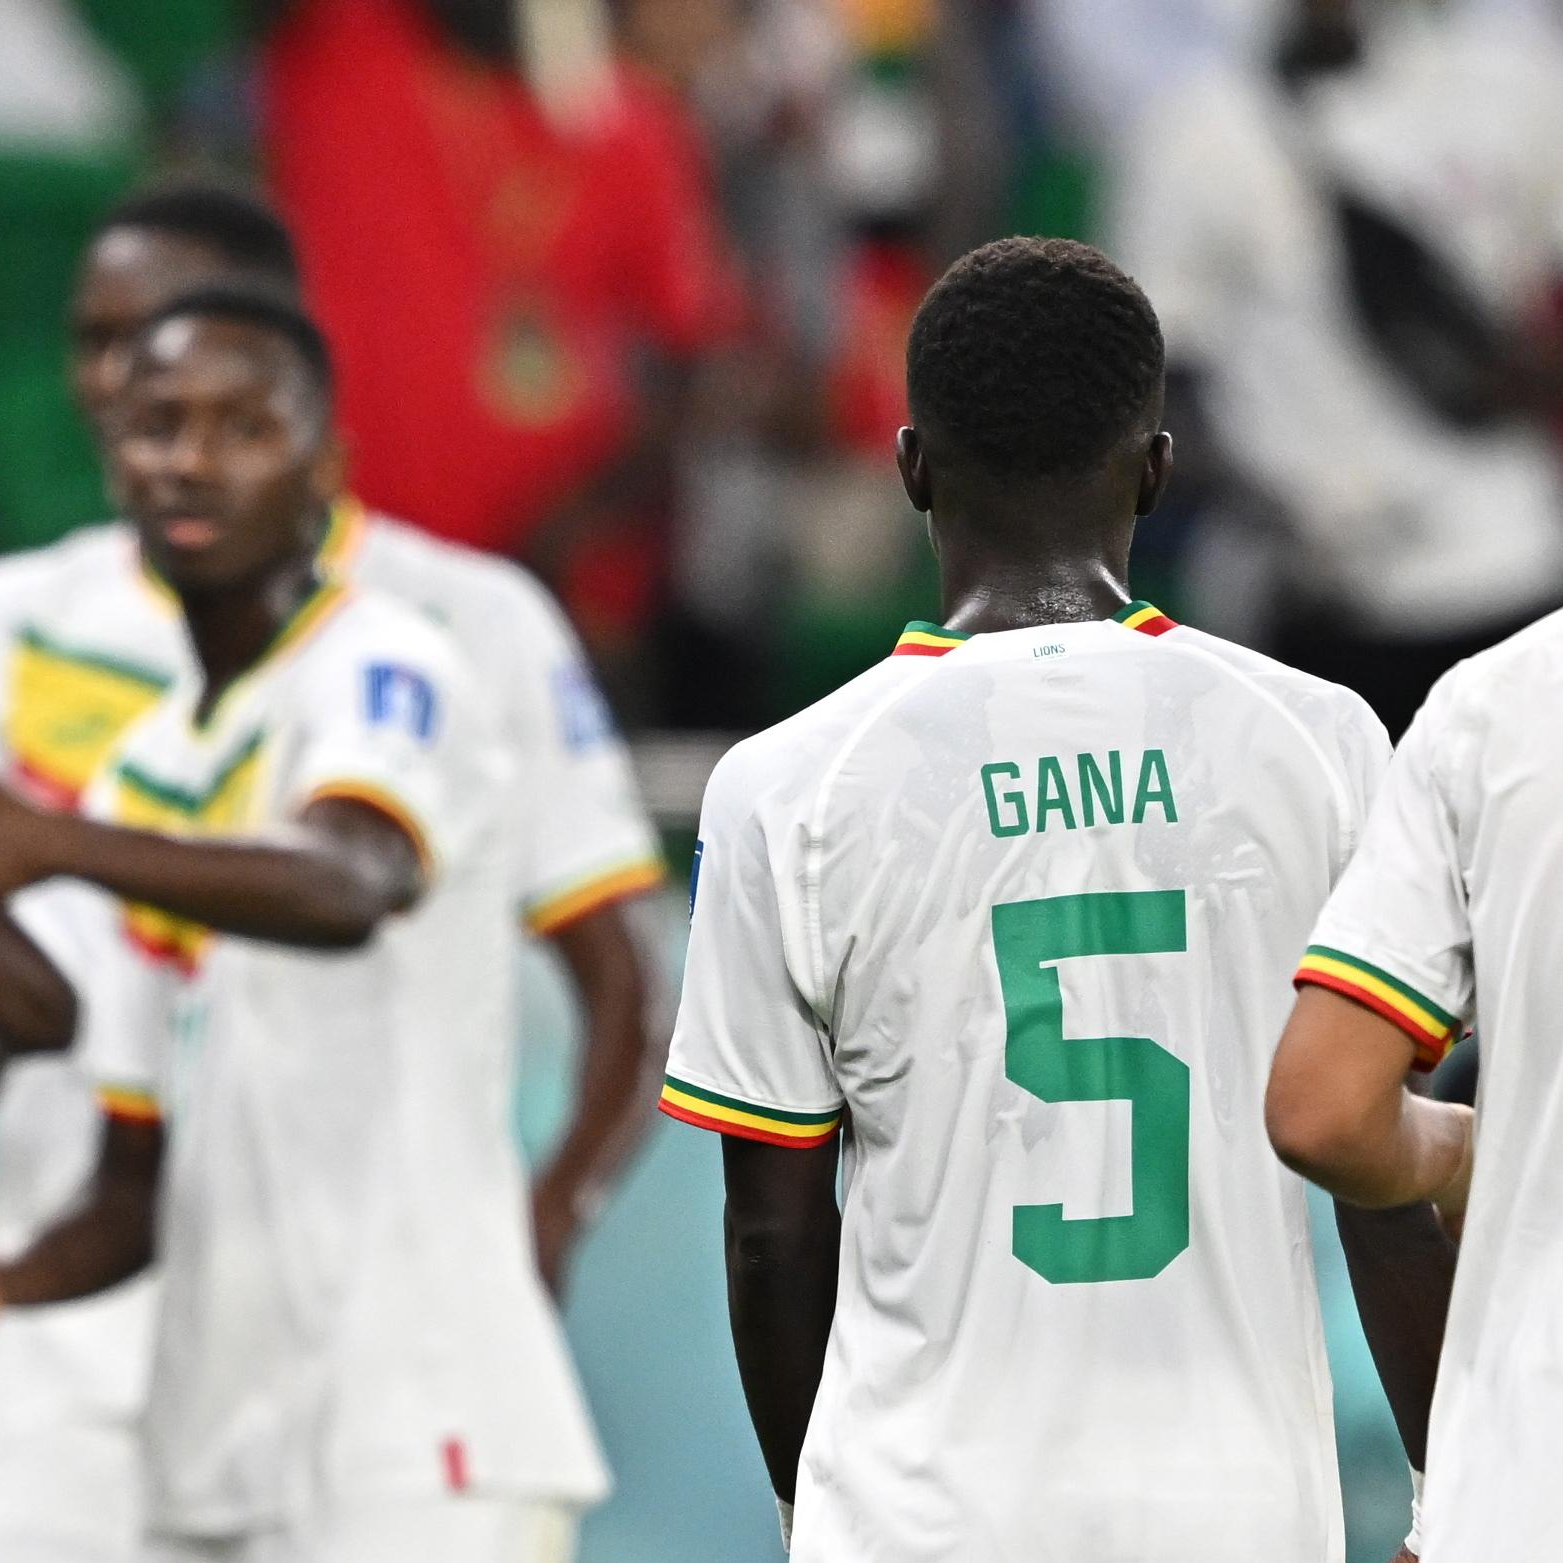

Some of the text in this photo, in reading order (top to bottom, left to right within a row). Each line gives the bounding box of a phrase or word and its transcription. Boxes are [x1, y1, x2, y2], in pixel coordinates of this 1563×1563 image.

[1033, 643, 1066, 658] LIONS
[980, 749, 1178, 838] GANA
[991, 889, 1191, 1285] 5
